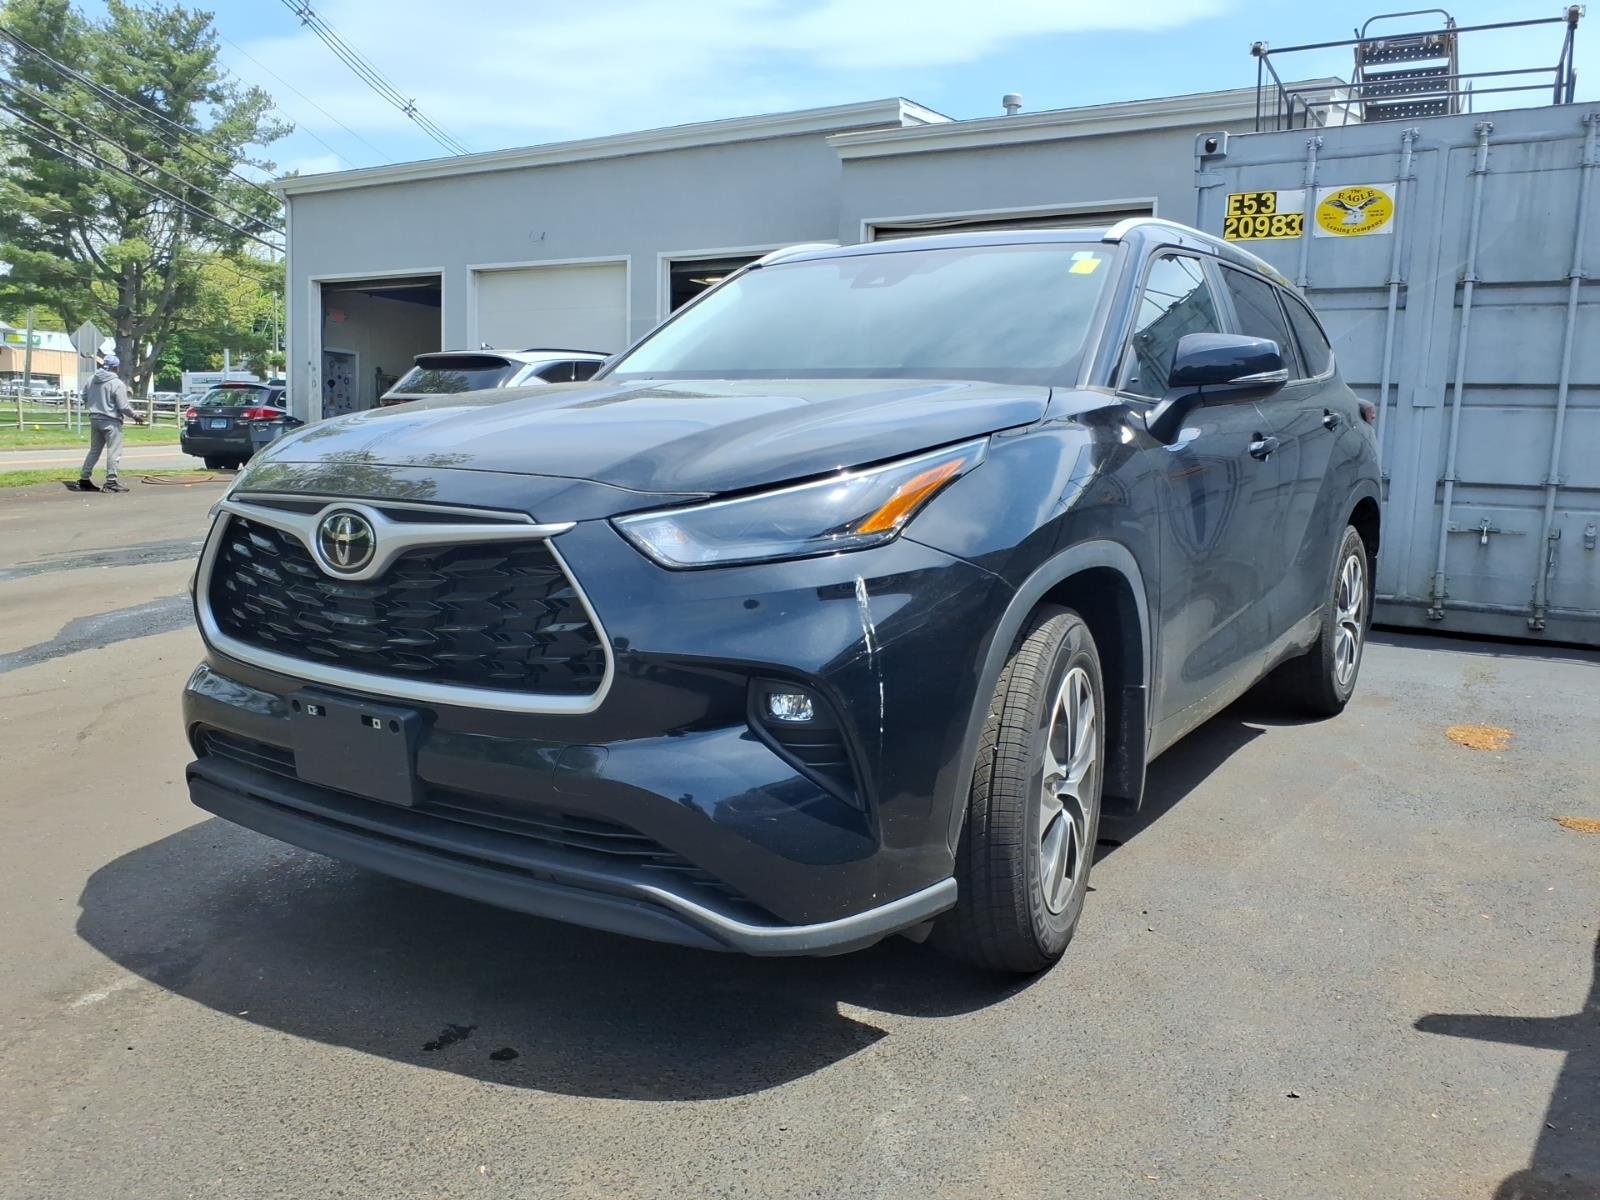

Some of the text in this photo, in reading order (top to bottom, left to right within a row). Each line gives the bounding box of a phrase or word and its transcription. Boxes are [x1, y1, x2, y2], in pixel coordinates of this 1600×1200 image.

[1338, 190, 1375, 202] EAGLE
[1228, 193, 1275, 215] E53
[1326, 219, 1383, 234] Leasing Company
